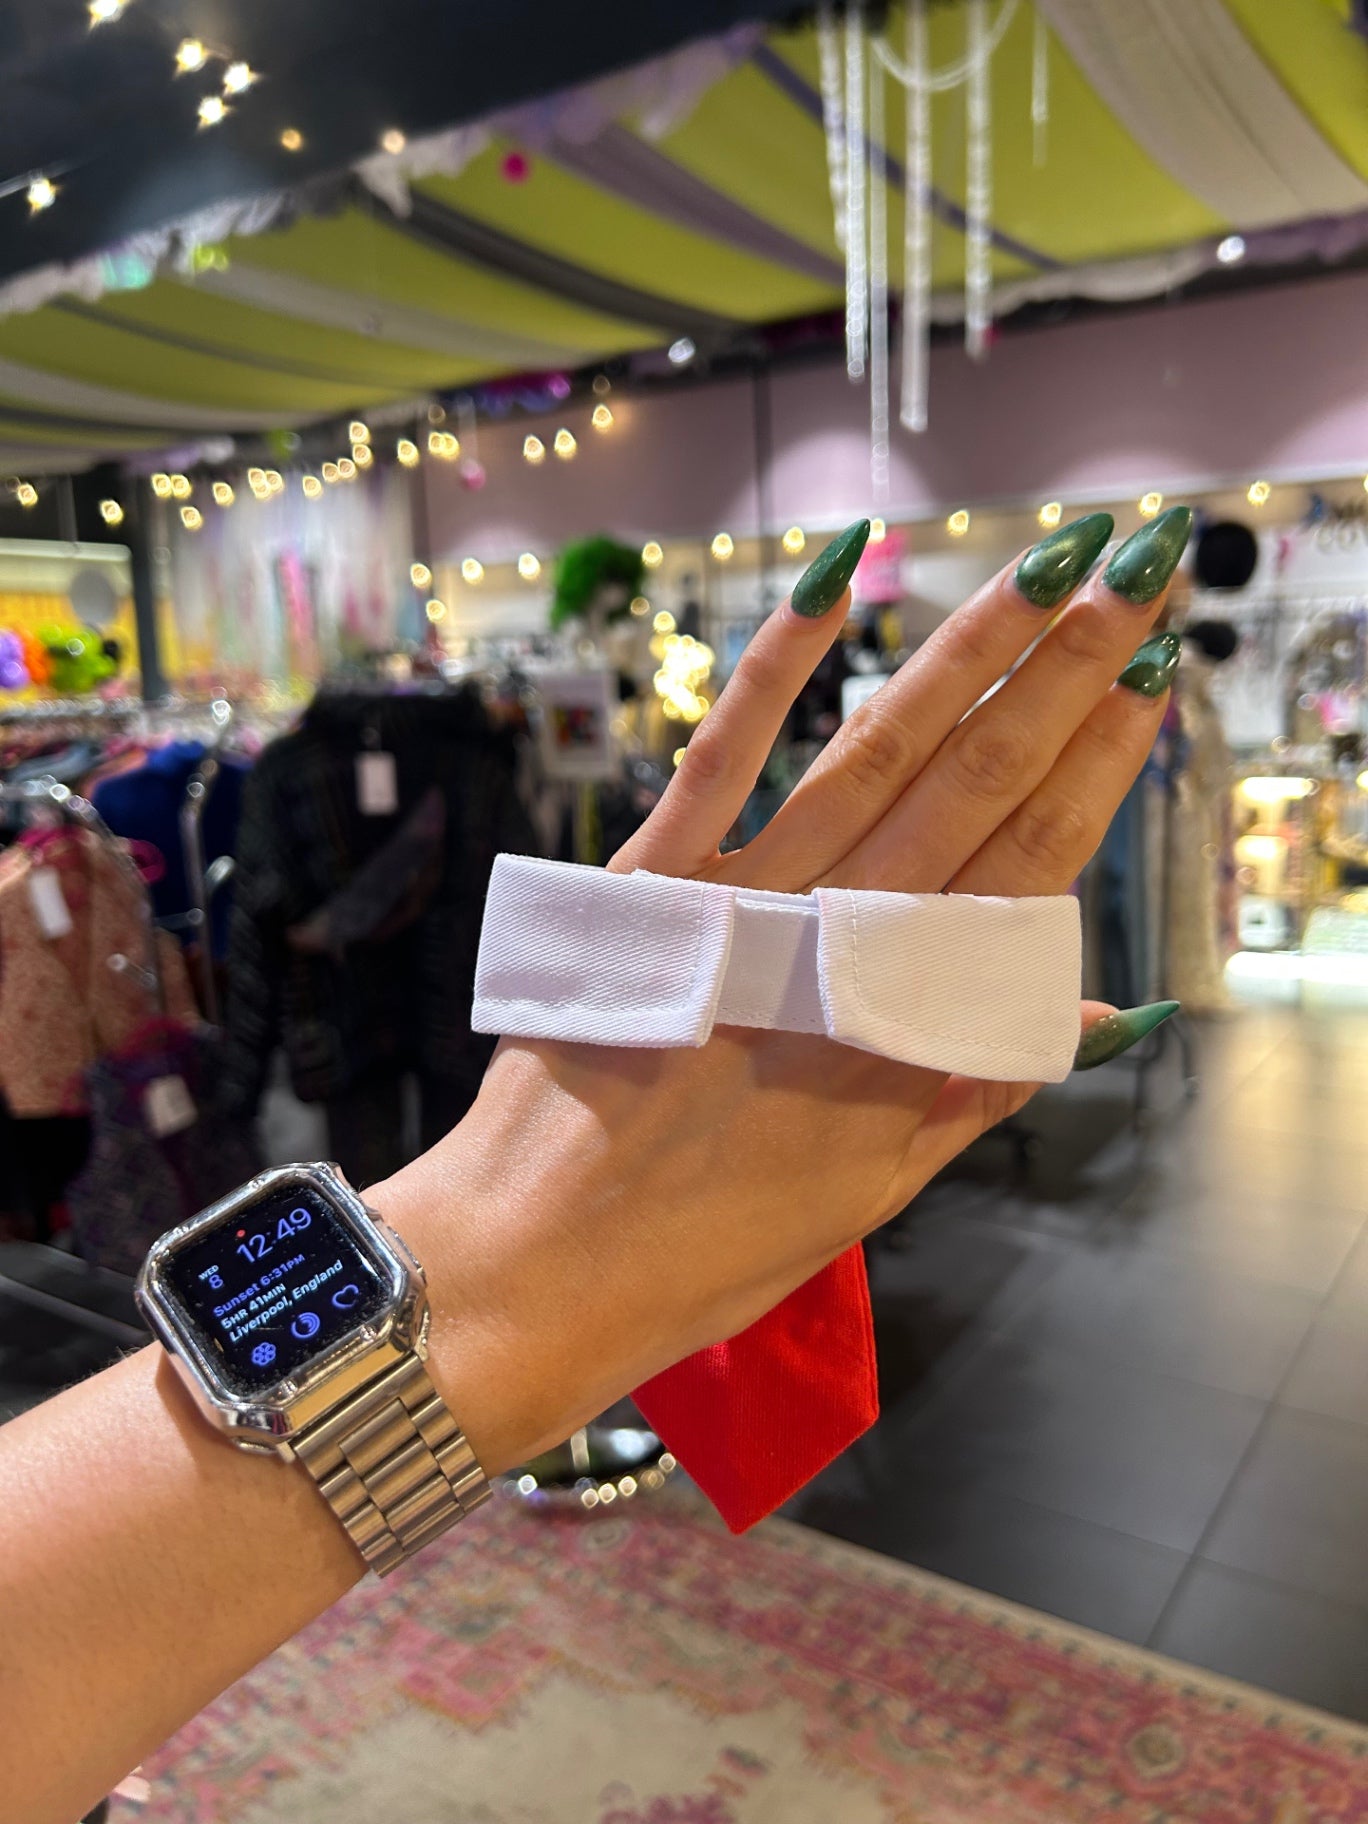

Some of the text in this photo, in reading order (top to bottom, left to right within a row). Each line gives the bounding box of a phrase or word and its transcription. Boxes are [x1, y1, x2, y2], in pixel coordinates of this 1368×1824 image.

[237, 1208, 312, 1263] 12:49
[198, 1265, 219, 1280] WED
[208, 1274, 223, 1289] 8
[213, 1254, 305, 1317] Sunset 6:31PM
[221, 1284, 286, 1330] 5HR 41MIN
[229, 1260, 343, 1343] Liverpool, England
